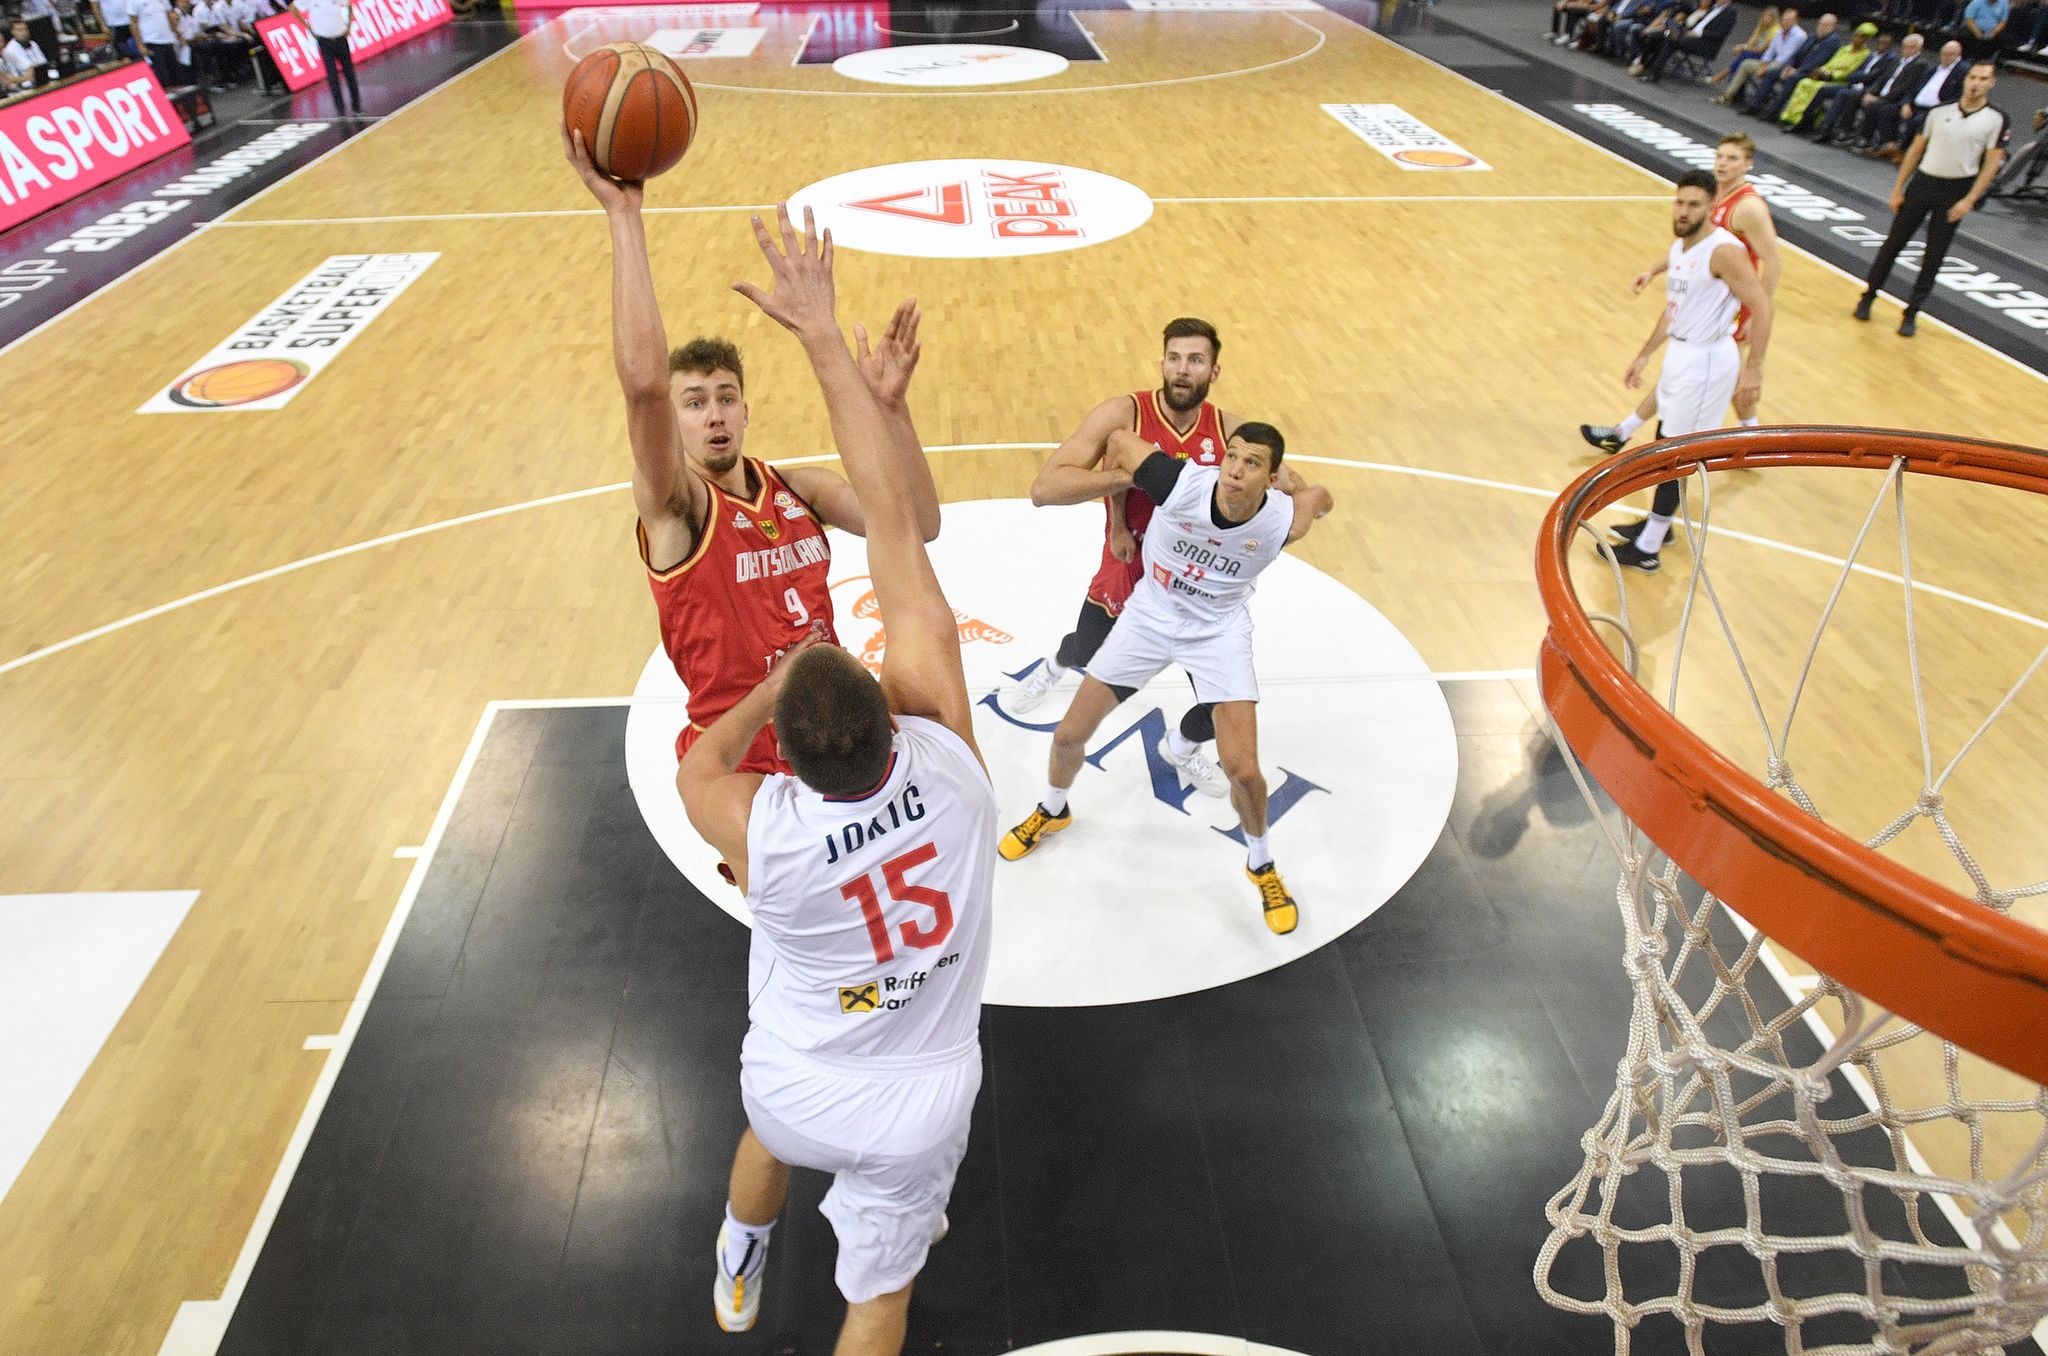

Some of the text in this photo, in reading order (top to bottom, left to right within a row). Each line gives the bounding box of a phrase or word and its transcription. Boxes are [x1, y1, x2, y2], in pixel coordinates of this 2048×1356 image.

[290, 0, 401, 69] MENTA
[25, 76, 171, 181] SPORT
[44, 199, 192, 253] 2022
[151, 122, 332, 197] HAMBURG
[982, 169, 1085, 238] PEAK
[228, 255, 374, 350] BASKETBALL
[285, 254, 423, 349] SUPERCUP
[1173, 540, 1241, 577] SRBIJA
[783, 587, 809, 627] 9
[826, 780, 926, 865] JOKIĆ
[839, 841, 955, 966] 15
